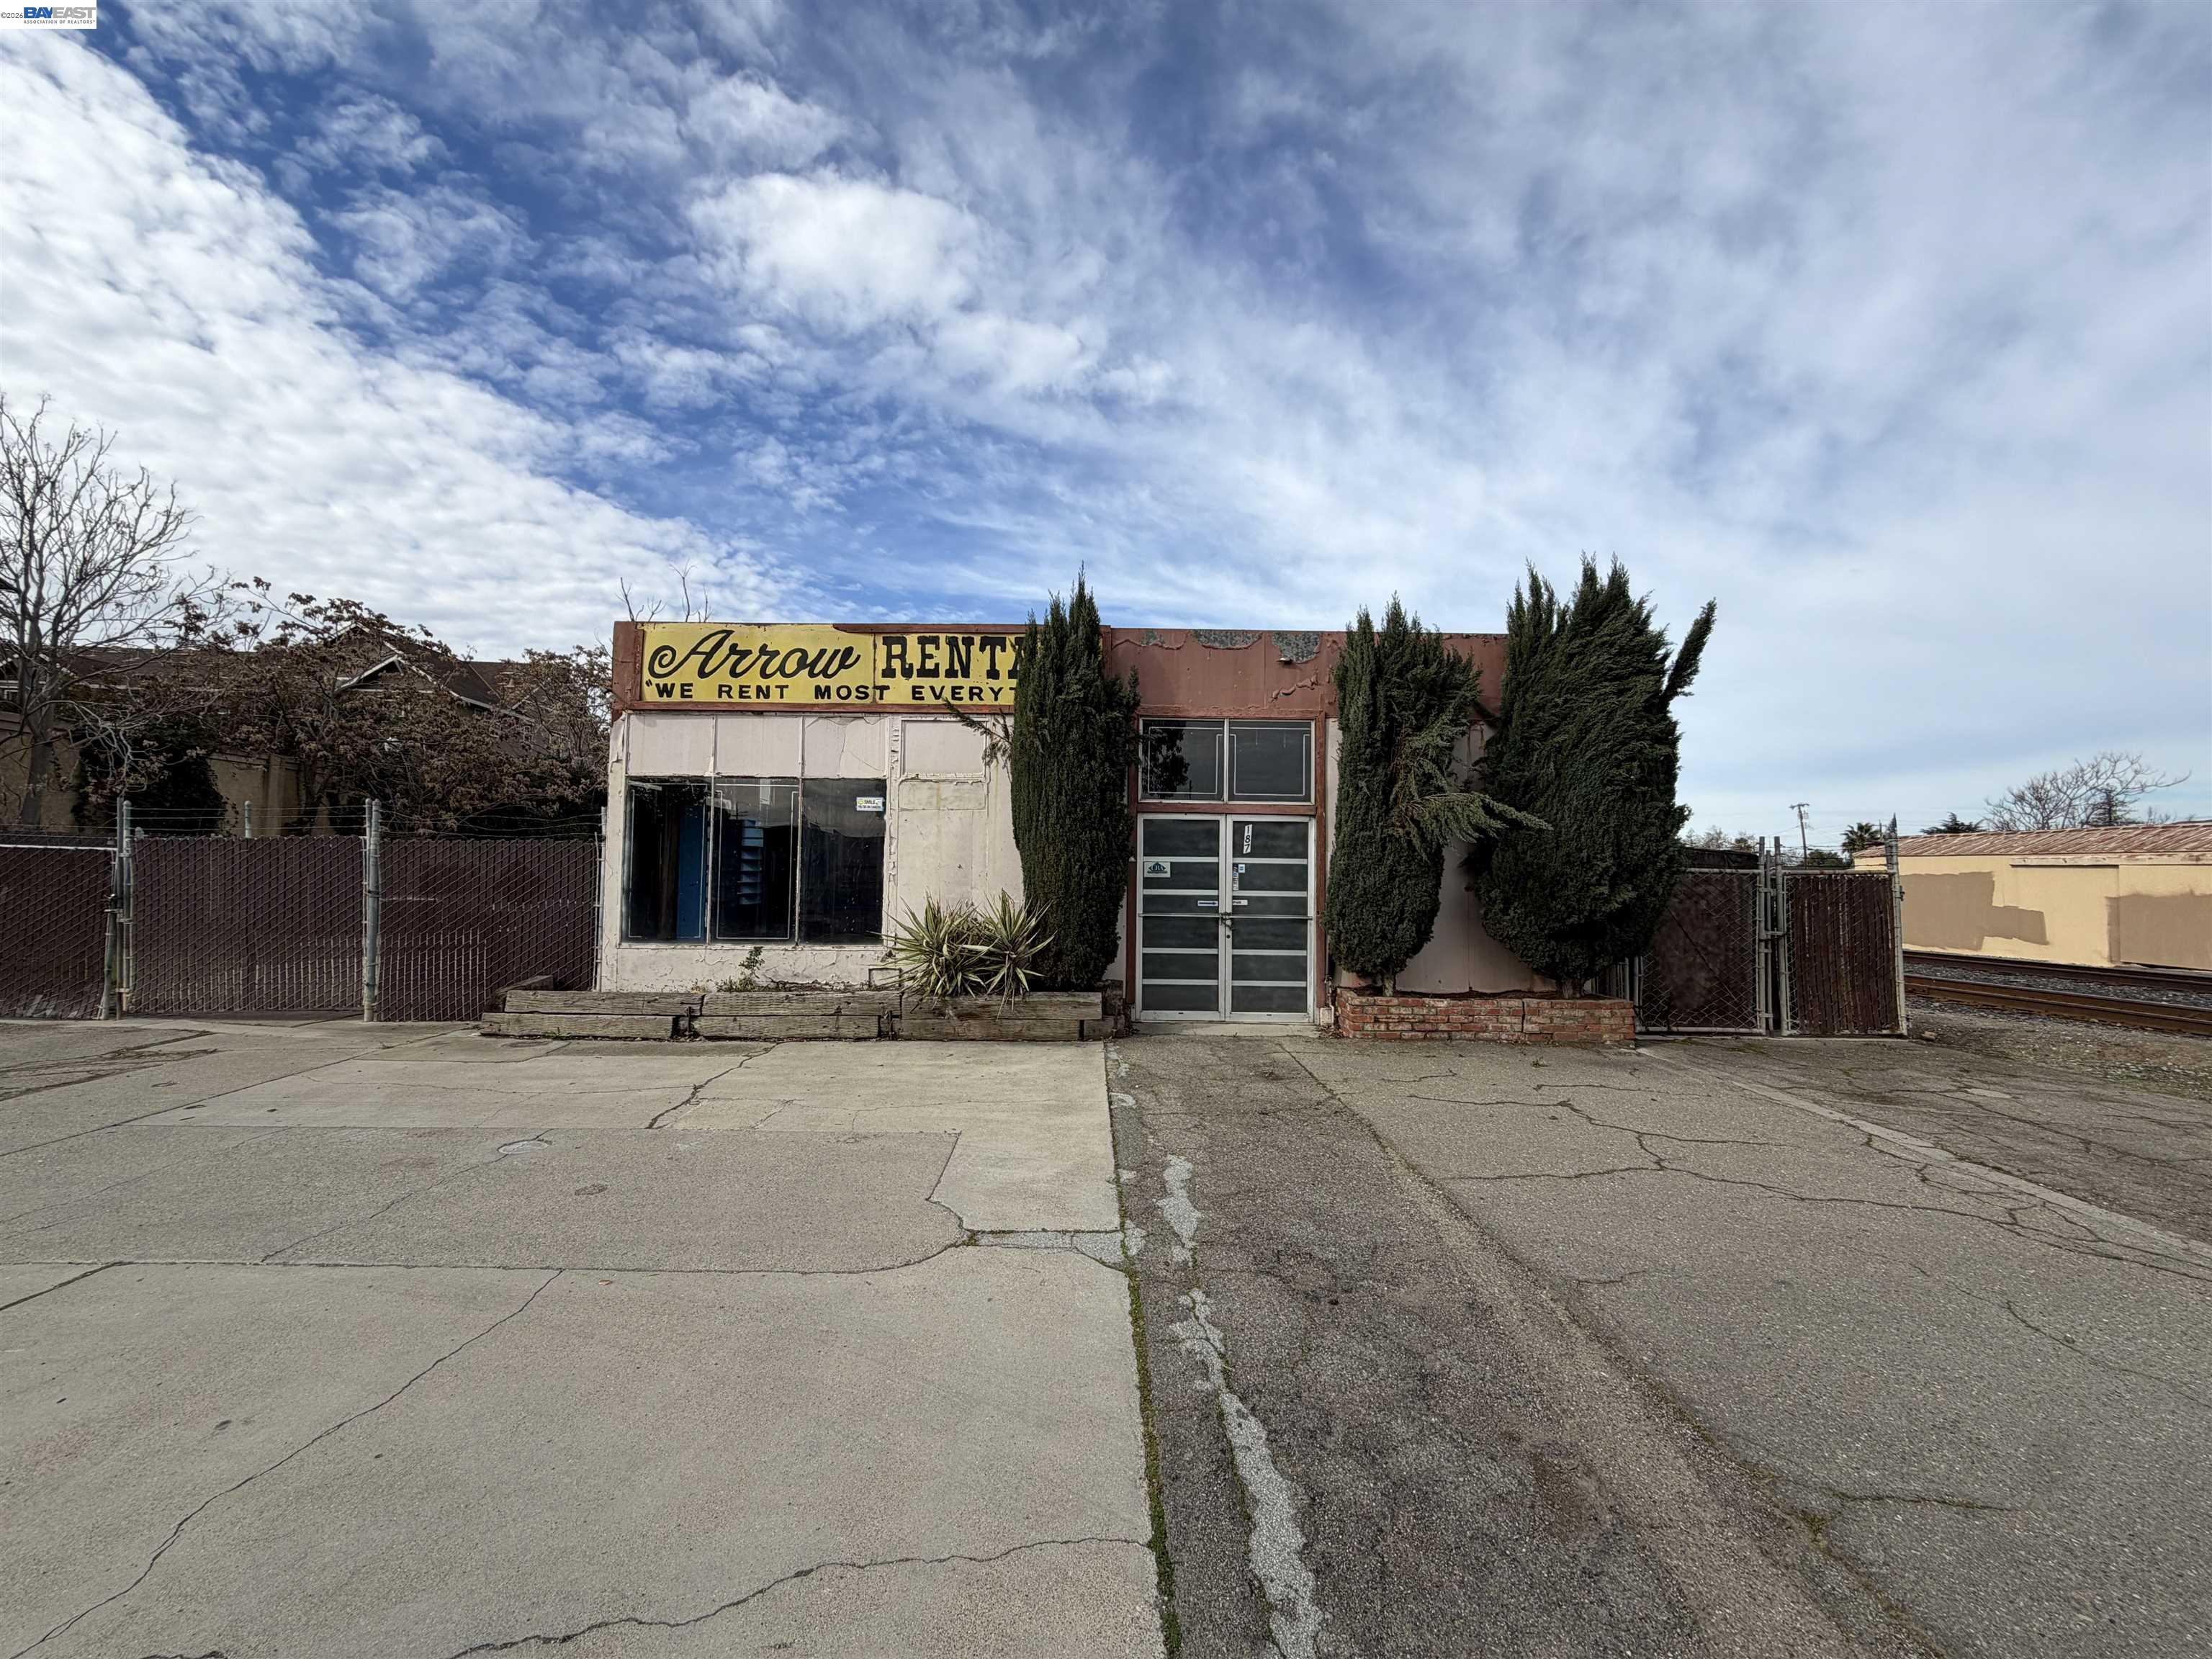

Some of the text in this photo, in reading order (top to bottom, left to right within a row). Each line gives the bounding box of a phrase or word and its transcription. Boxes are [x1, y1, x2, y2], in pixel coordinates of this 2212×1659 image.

[648, 629, 860, 679] Arrow
[718, 683, 789, 699] RENT
[814, 685, 890, 701] MOST
